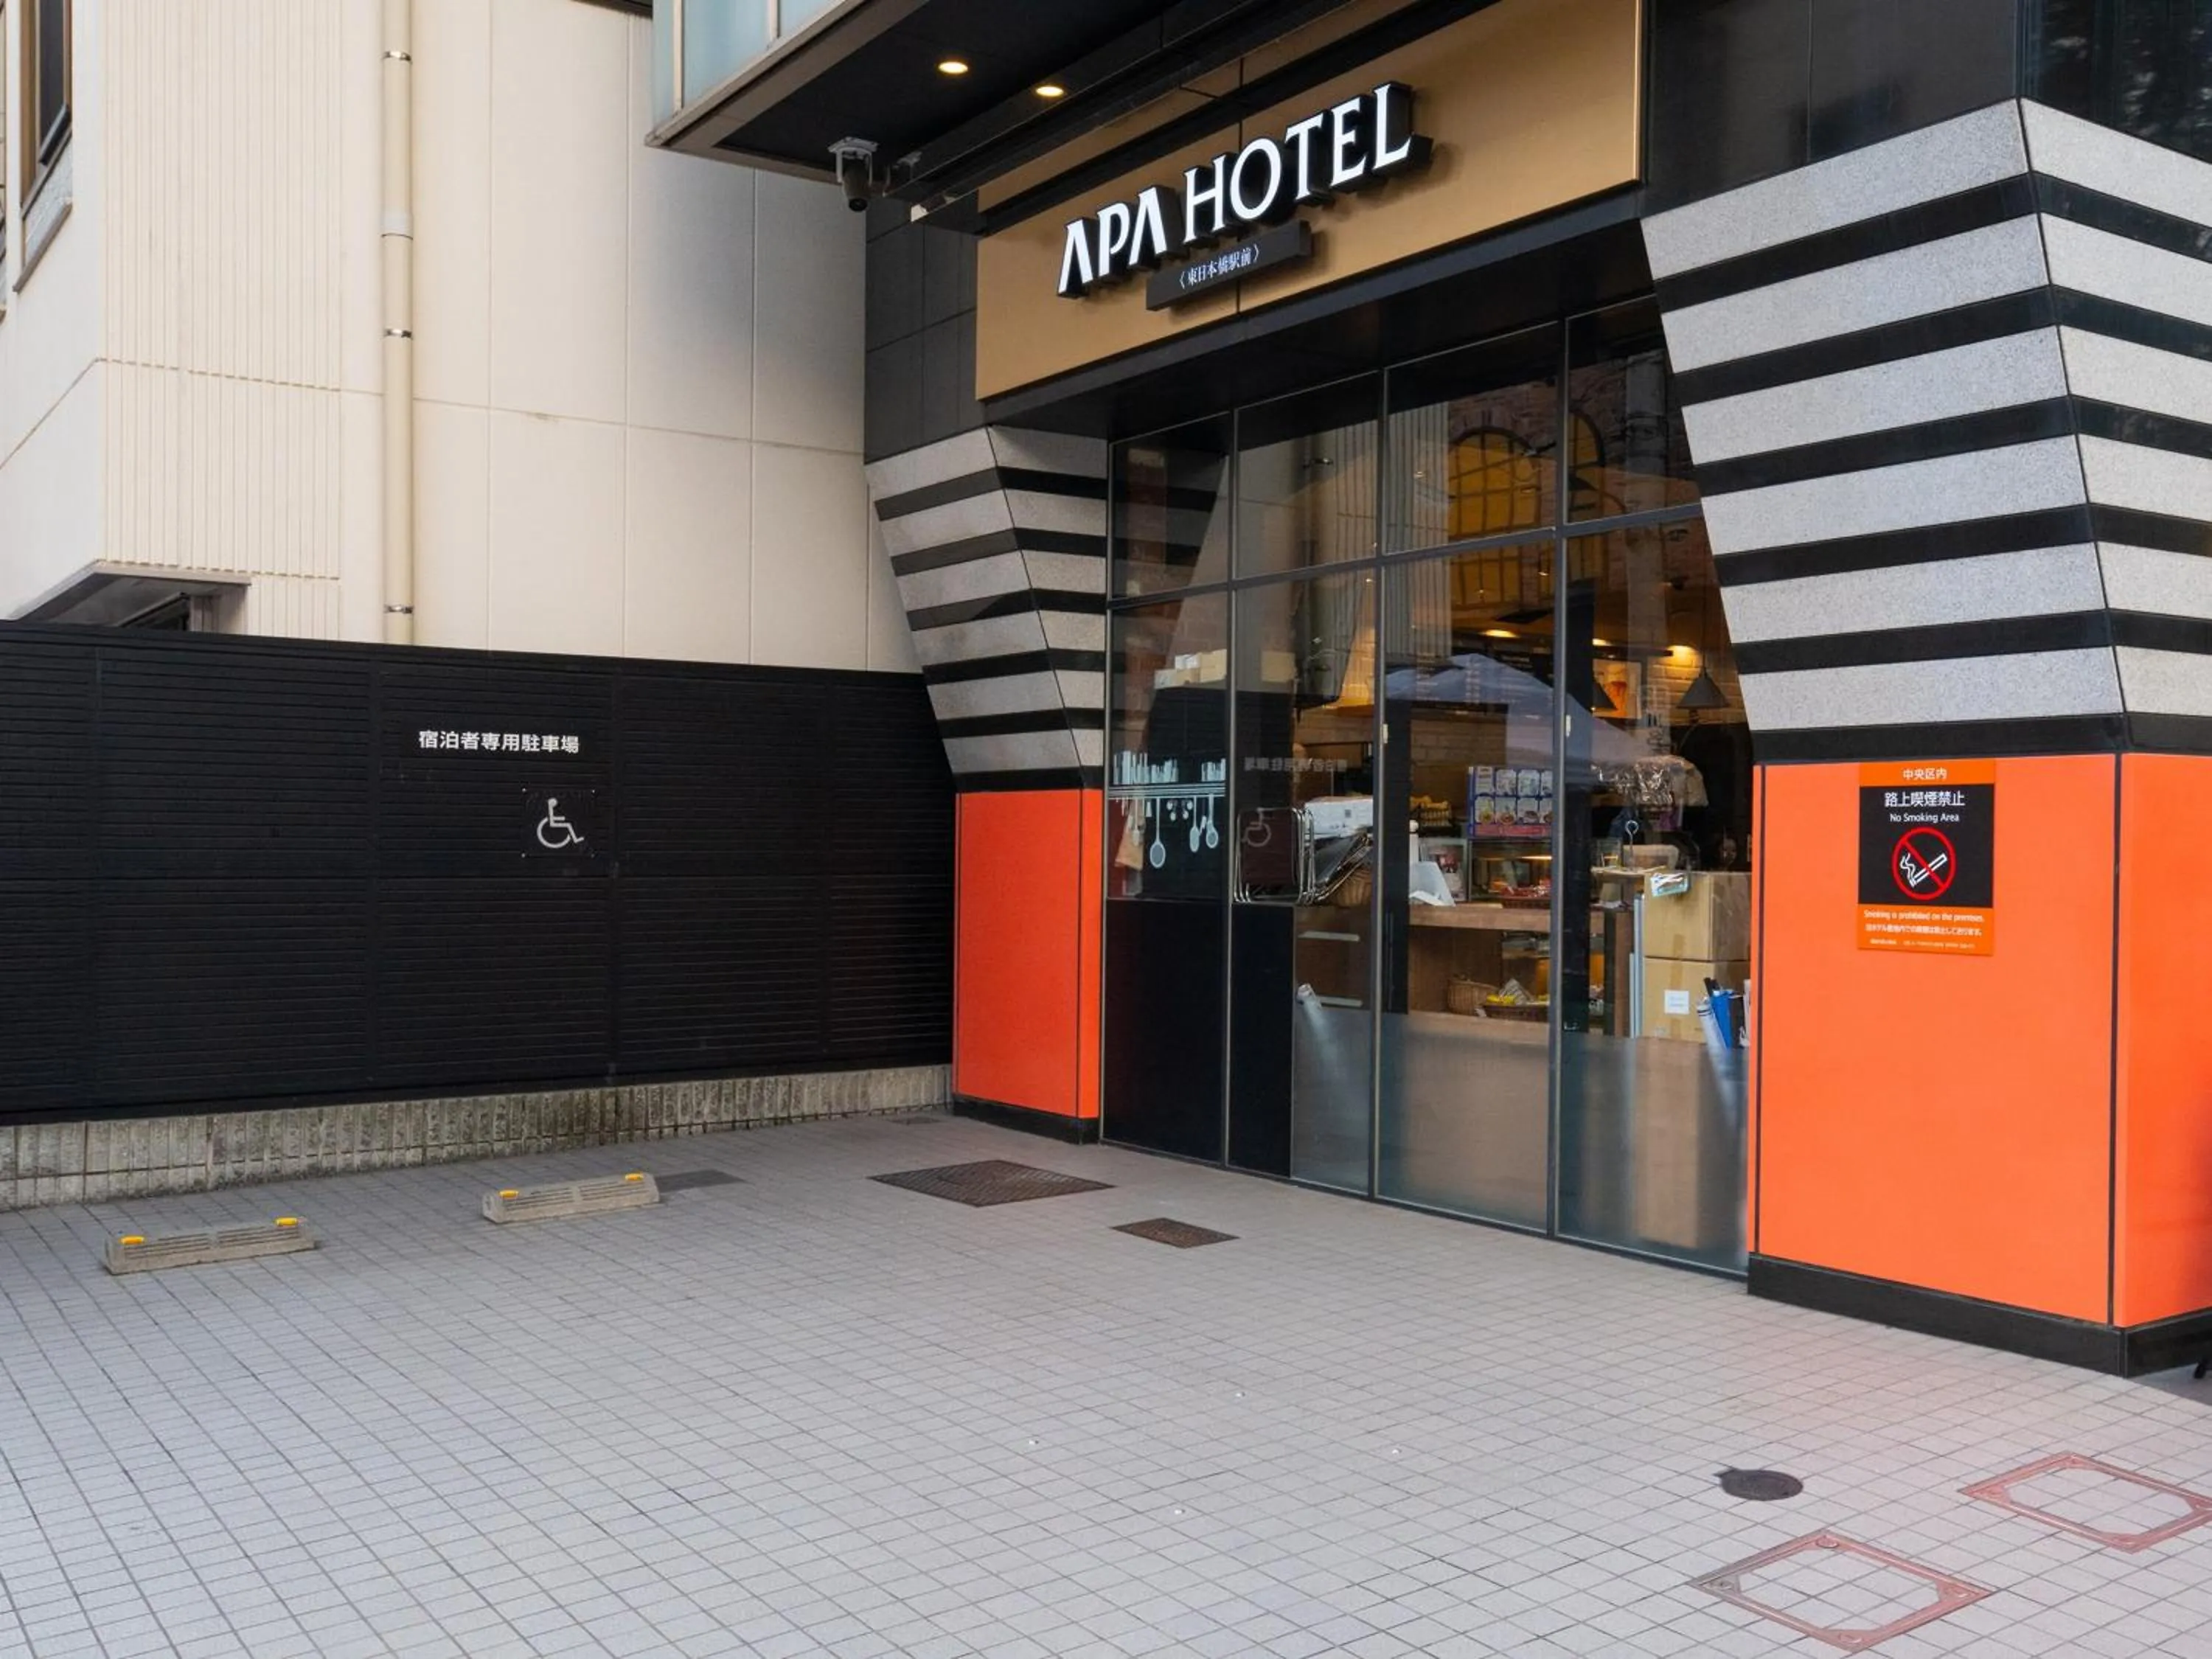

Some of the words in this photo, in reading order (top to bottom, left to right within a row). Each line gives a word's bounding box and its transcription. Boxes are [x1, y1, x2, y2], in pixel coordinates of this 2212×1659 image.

[1058, 186, 1168, 293] APA
[1183, 83, 1413, 243] HOTEL
[419, 730, 580, 754] 宿泊者専用駐車場
[1902, 768, 1947, 780] 中央区内
[1884, 790, 1966, 807] 路上喫煙禁止
[1890, 813, 1902, 822] No
[1903, 813, 1938, 824] Smoking
[1940, 813, 1960, 822] Area
